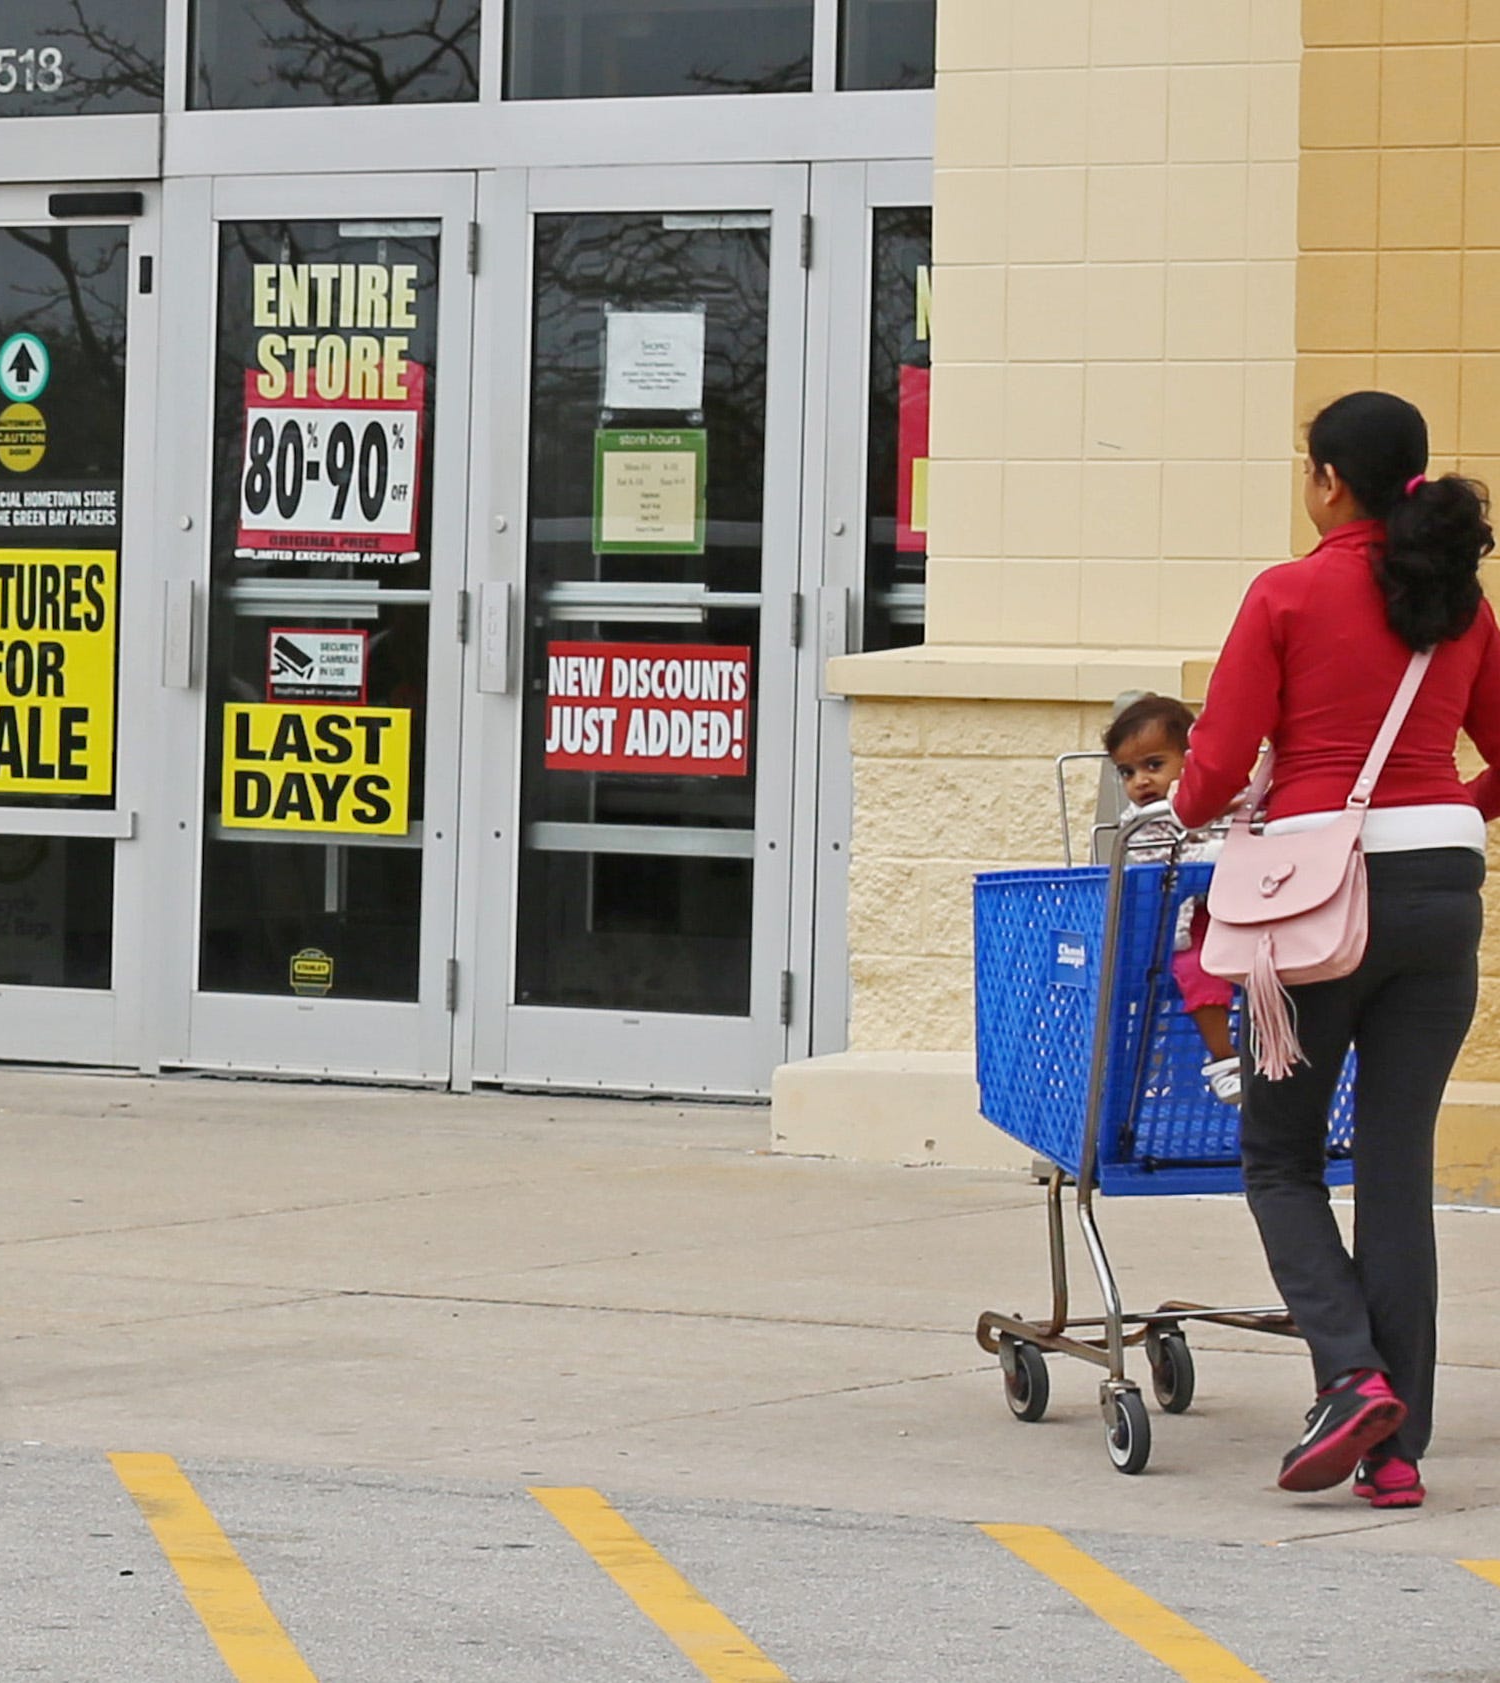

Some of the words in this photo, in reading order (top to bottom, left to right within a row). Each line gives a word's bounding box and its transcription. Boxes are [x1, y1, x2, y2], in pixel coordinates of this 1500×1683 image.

[253, 263, 417, 328] ENTIRE
[257, 333, 409, 400] STORE
[619, 435, 647, 446] store
[649, 432, 681, 445] hours
[24, 492, 81, 507] HOMETOWN
[83, 491, 116, 507] STORE
[392, 485, 408, 501] OFF
[13, 511, 46, 526] GREEN
[49, 510, 68, 525] BAY
[70, 510, 116, 525] PACKERS
[269, 535, 334, 547] ORIGINAL
[340, 537, 380, 548] PRICE
[253, 549, 293, 560] LIMITED
[295, 551, 360, 562] EXCEPTIONS
[362, 552, 397, 563] APPLY
[320, 643, 359, 651] SECURITY
[320, 655, 358, 663] CAMERAS
[320, 667, 328, 675] IN
[330, 667, 345, 676] USE
[548, 656, 604, 697] NEW
[612, 658, 747, 702] DISCOUNTS
[235, 712, 392, 765] LAST
[546, 706, 617, 755] JUST
[624, 708, 743, 760] ADDED!
[234, 770, 391, 825] DAYS
